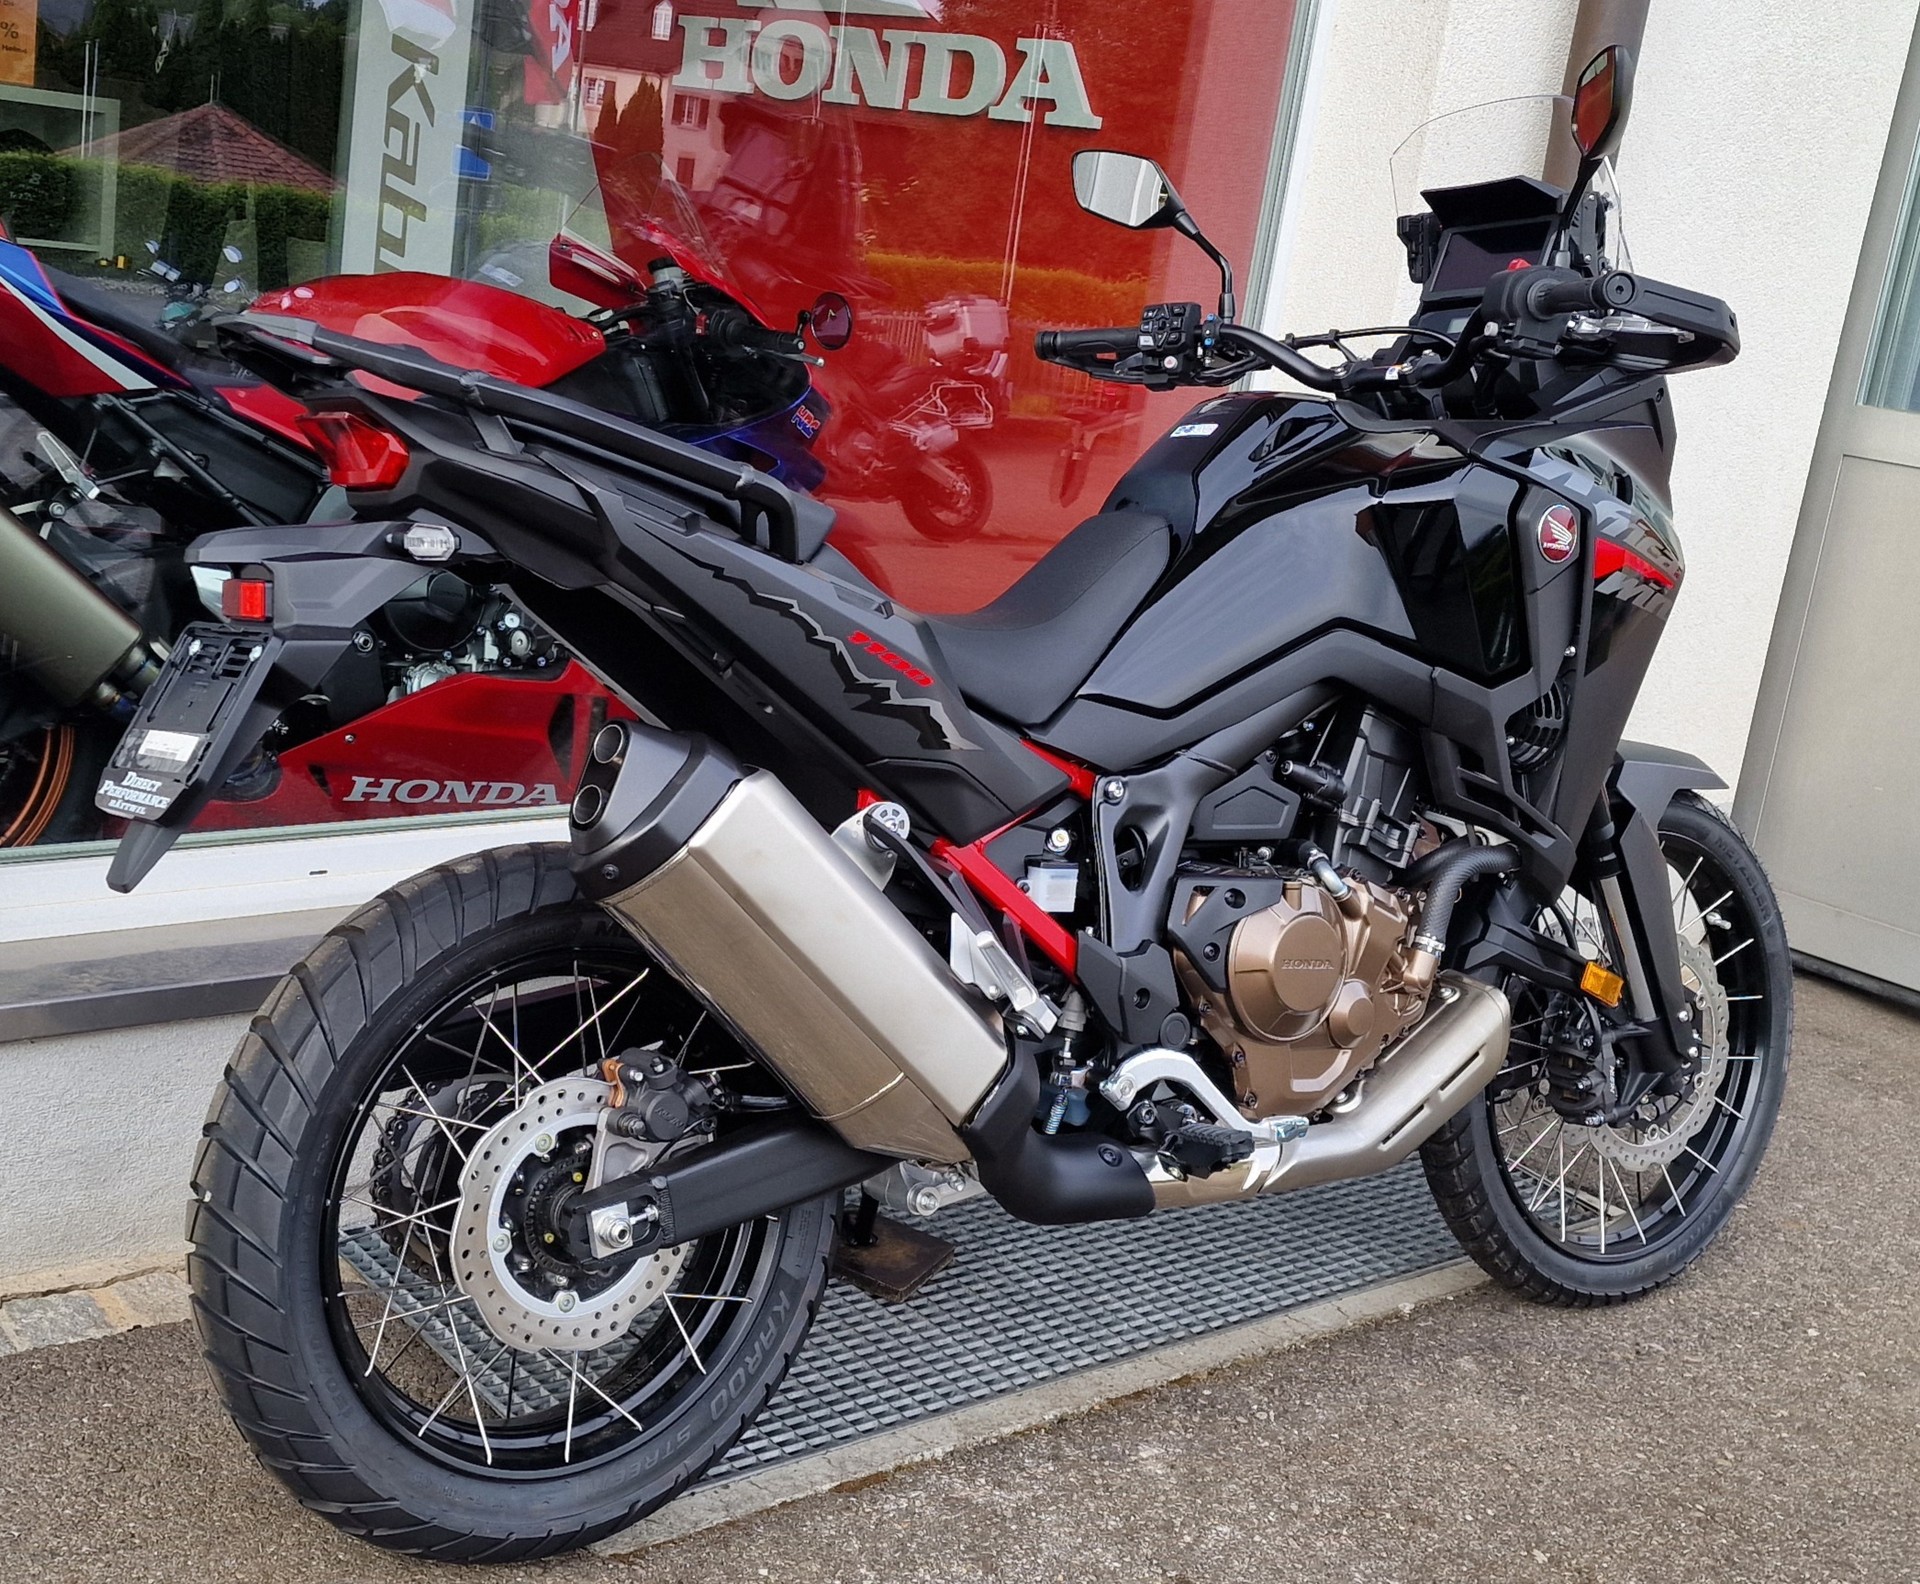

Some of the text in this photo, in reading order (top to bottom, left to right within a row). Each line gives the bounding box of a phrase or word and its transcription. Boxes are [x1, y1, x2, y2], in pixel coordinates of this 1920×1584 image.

[672, 14, 1103, 130] HONDA
[342, 775, 560, 805] HONDA
[1281, 959, 1335, 970] HONDA
[711, 1289, 790, 1420] KAROO
